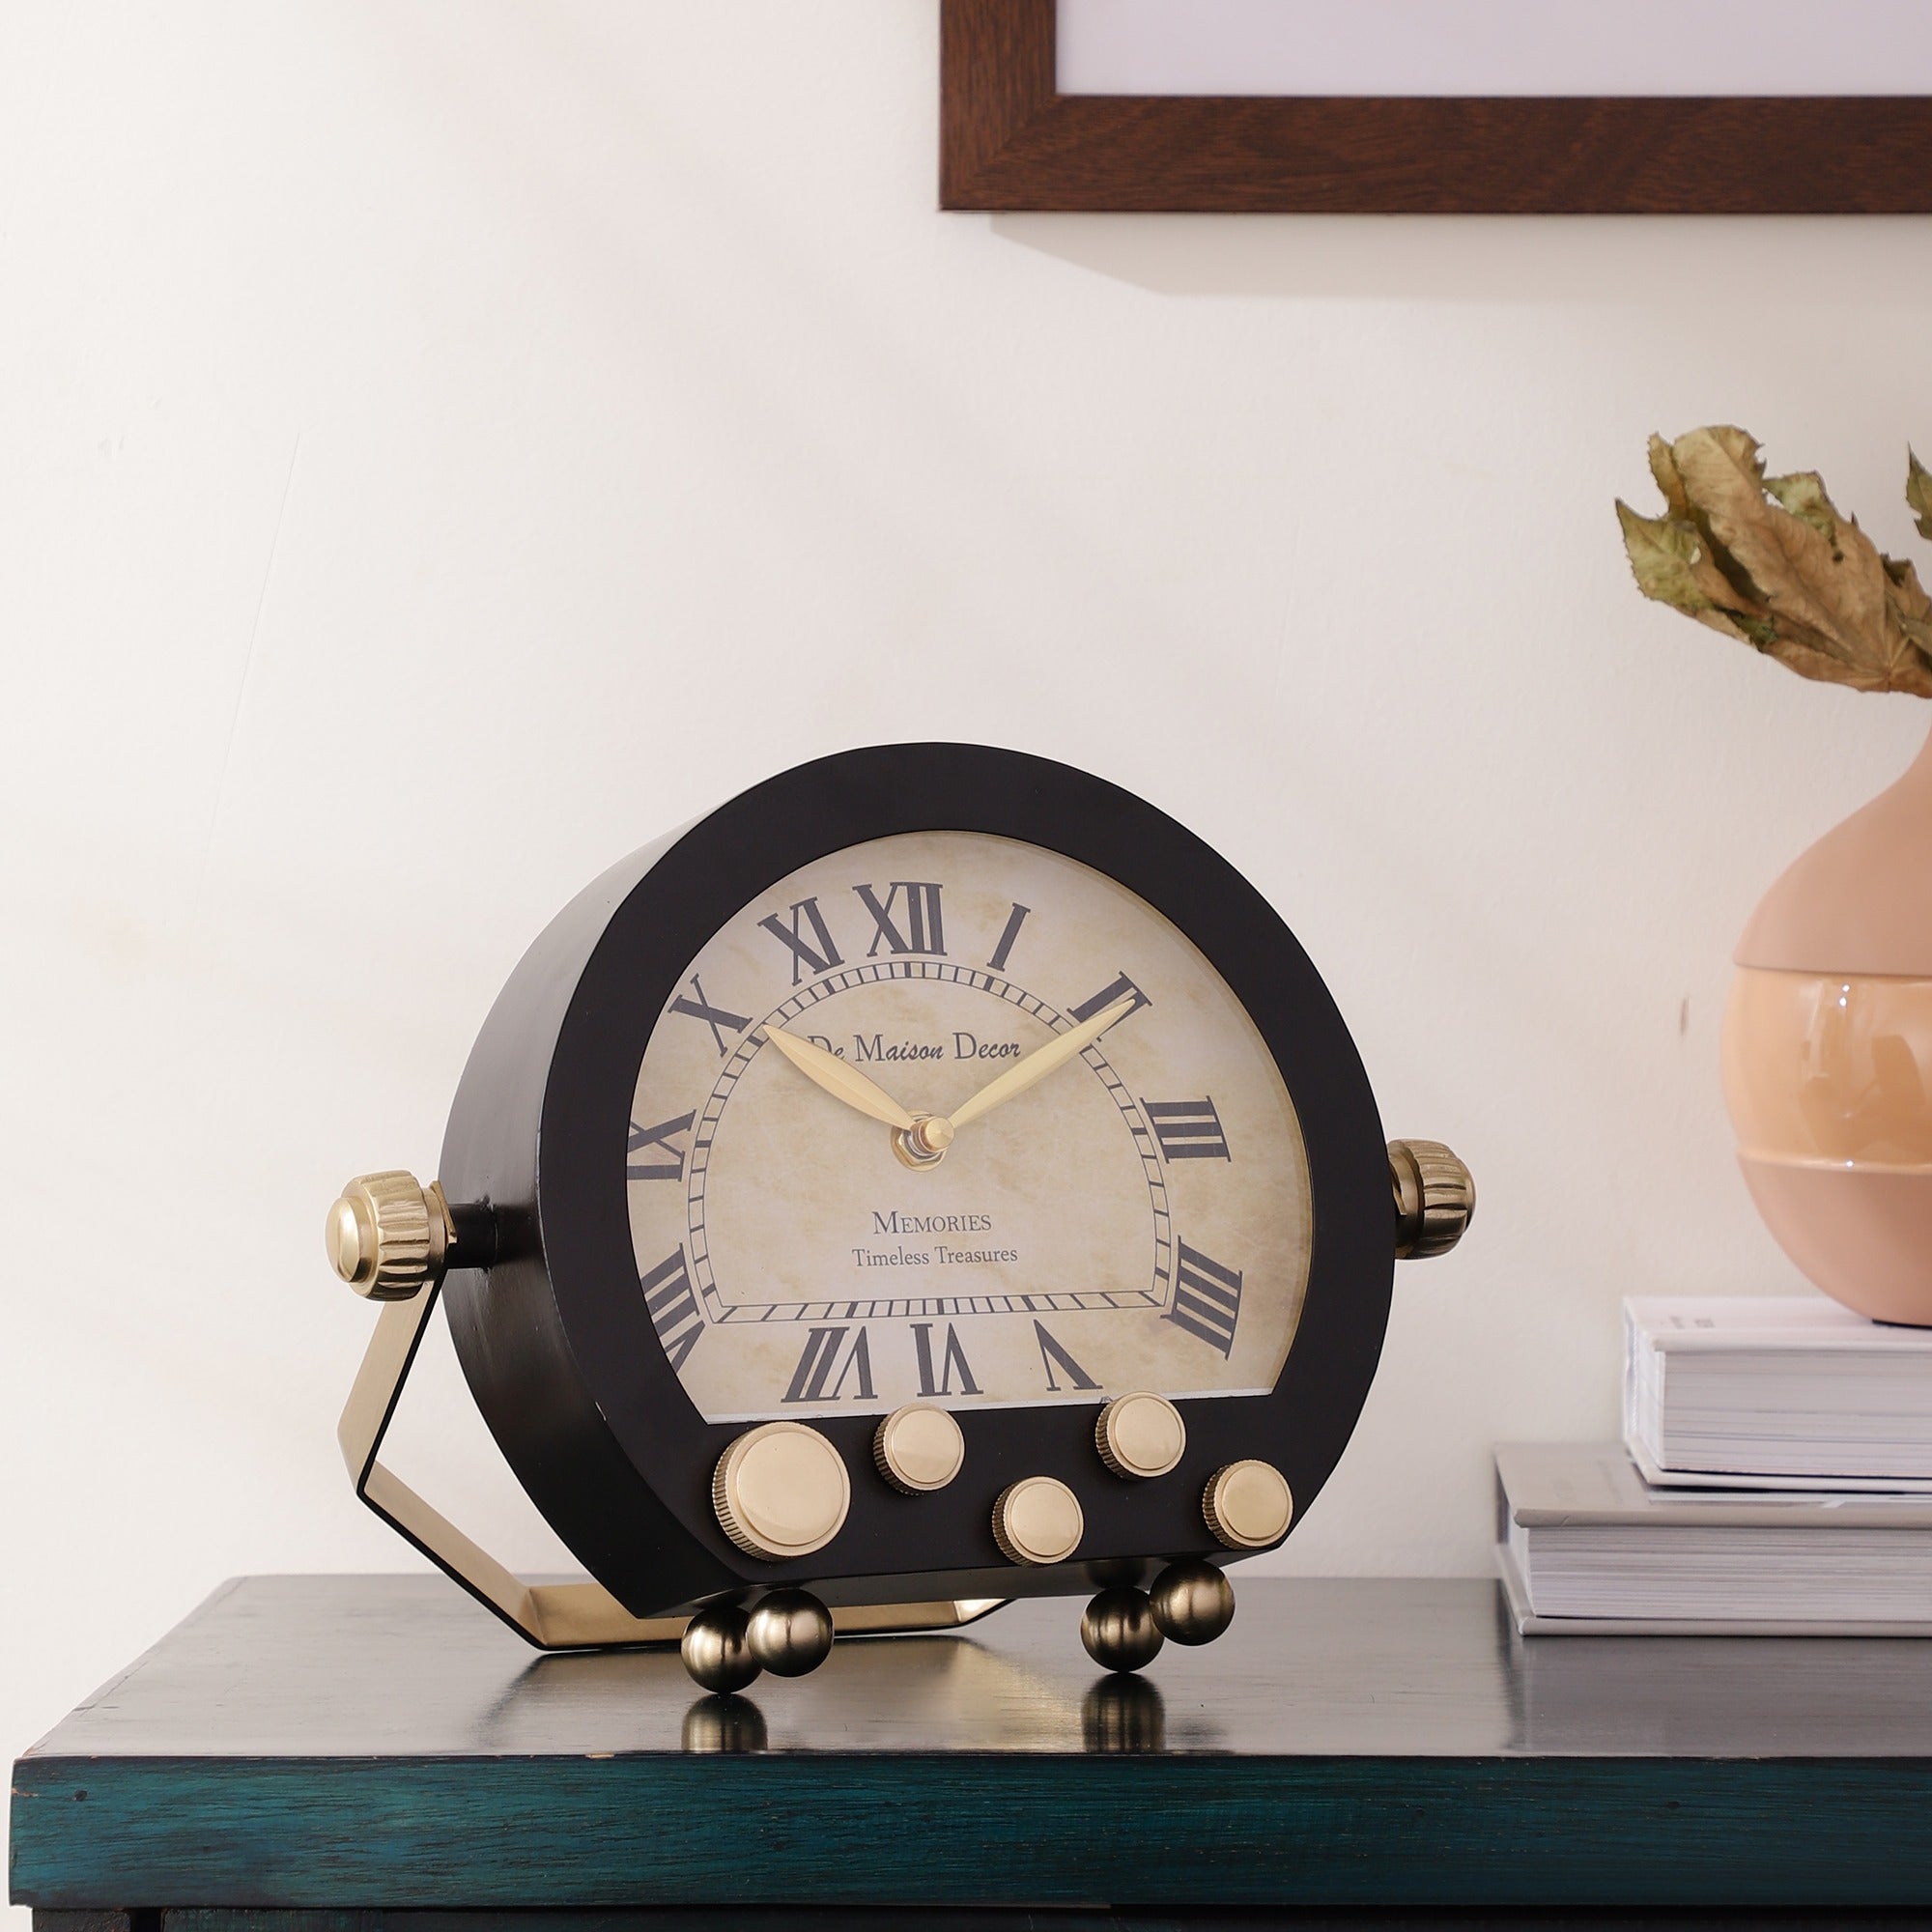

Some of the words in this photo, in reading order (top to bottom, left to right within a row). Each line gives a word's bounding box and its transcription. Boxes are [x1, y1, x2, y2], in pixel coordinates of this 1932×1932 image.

[757, 896, 845, 986] XI
[852, 881, 948, 957] XII
[986, 902, 1031, 972] I
[668, 973, 753, 1058] X
[853, 1034, 944, 1062] Maison
[952, 1032, 1021, 1061] Decor
[627, 1109, 697, 1183] IX
[1139, 1095, 1232, 1164] III
[852, 1246, 929, 1267] Timeless
[934, 1245, 1018, 1264] Treasures
[872, 1210, 992, 1236] MEMORIES
[1160, 1235, 1242, 1361] IIII
[781, 1326, 878, 1403] VII
[910, 1322, 983, 1397] VI
[1033, 1319, 1103, 1391] V
